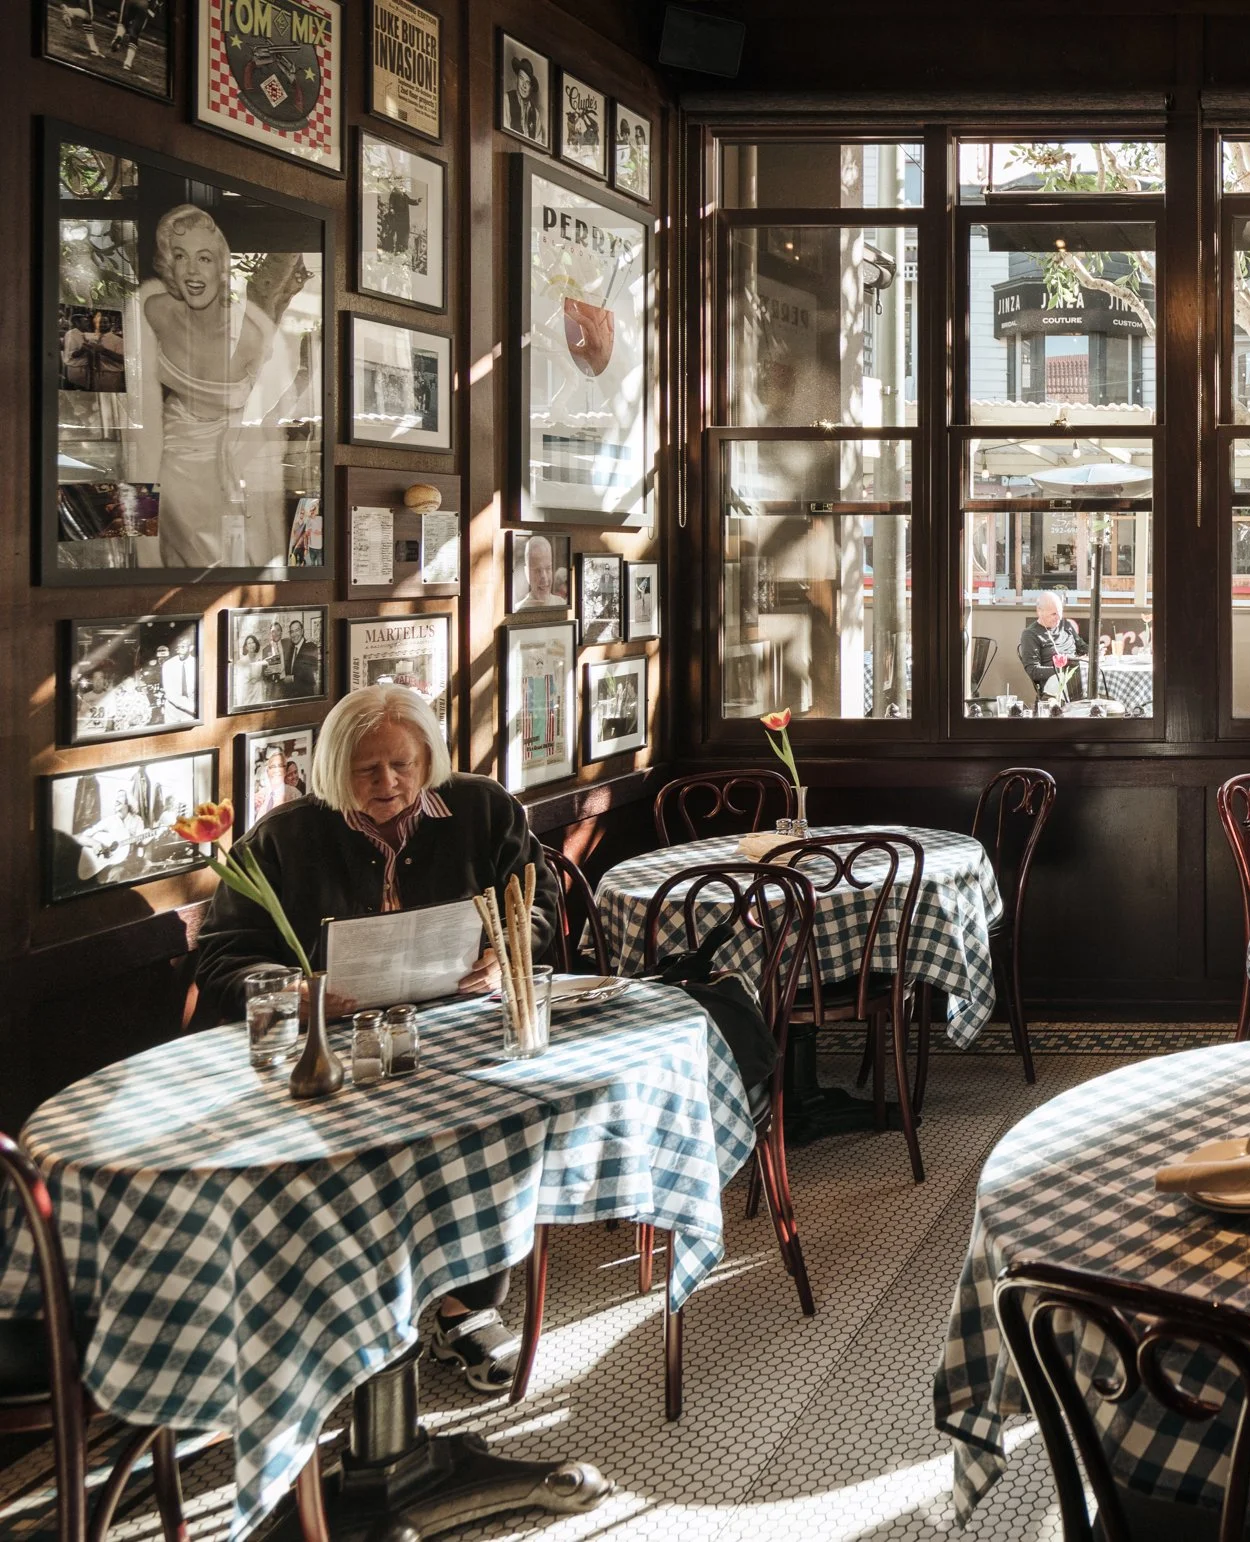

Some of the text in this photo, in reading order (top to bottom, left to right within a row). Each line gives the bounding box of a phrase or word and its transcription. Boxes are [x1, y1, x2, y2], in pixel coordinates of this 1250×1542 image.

[221, 0, 272, 38] TOM
[291, 10, 328, 47] MIX
[417, 9, 437, 27] EDITION
[375, 4, 400, 39] LUKE
[401, 19, 437, 59] BUTLER
[374, 30, 437, 94] INVASION!
[565, 84, 598, 112] Clyde's
[543, 205, 634, 265] PERRY'S
[998, 294, 1021, 316] JINZA
[1040, 292, 1085, 309] JNA
[1042, 316, 1083, 325] COUTURE
[1112, 319, 1143, 329] CUSTOM
[365, 624, 436, 644] MARTELL'S
